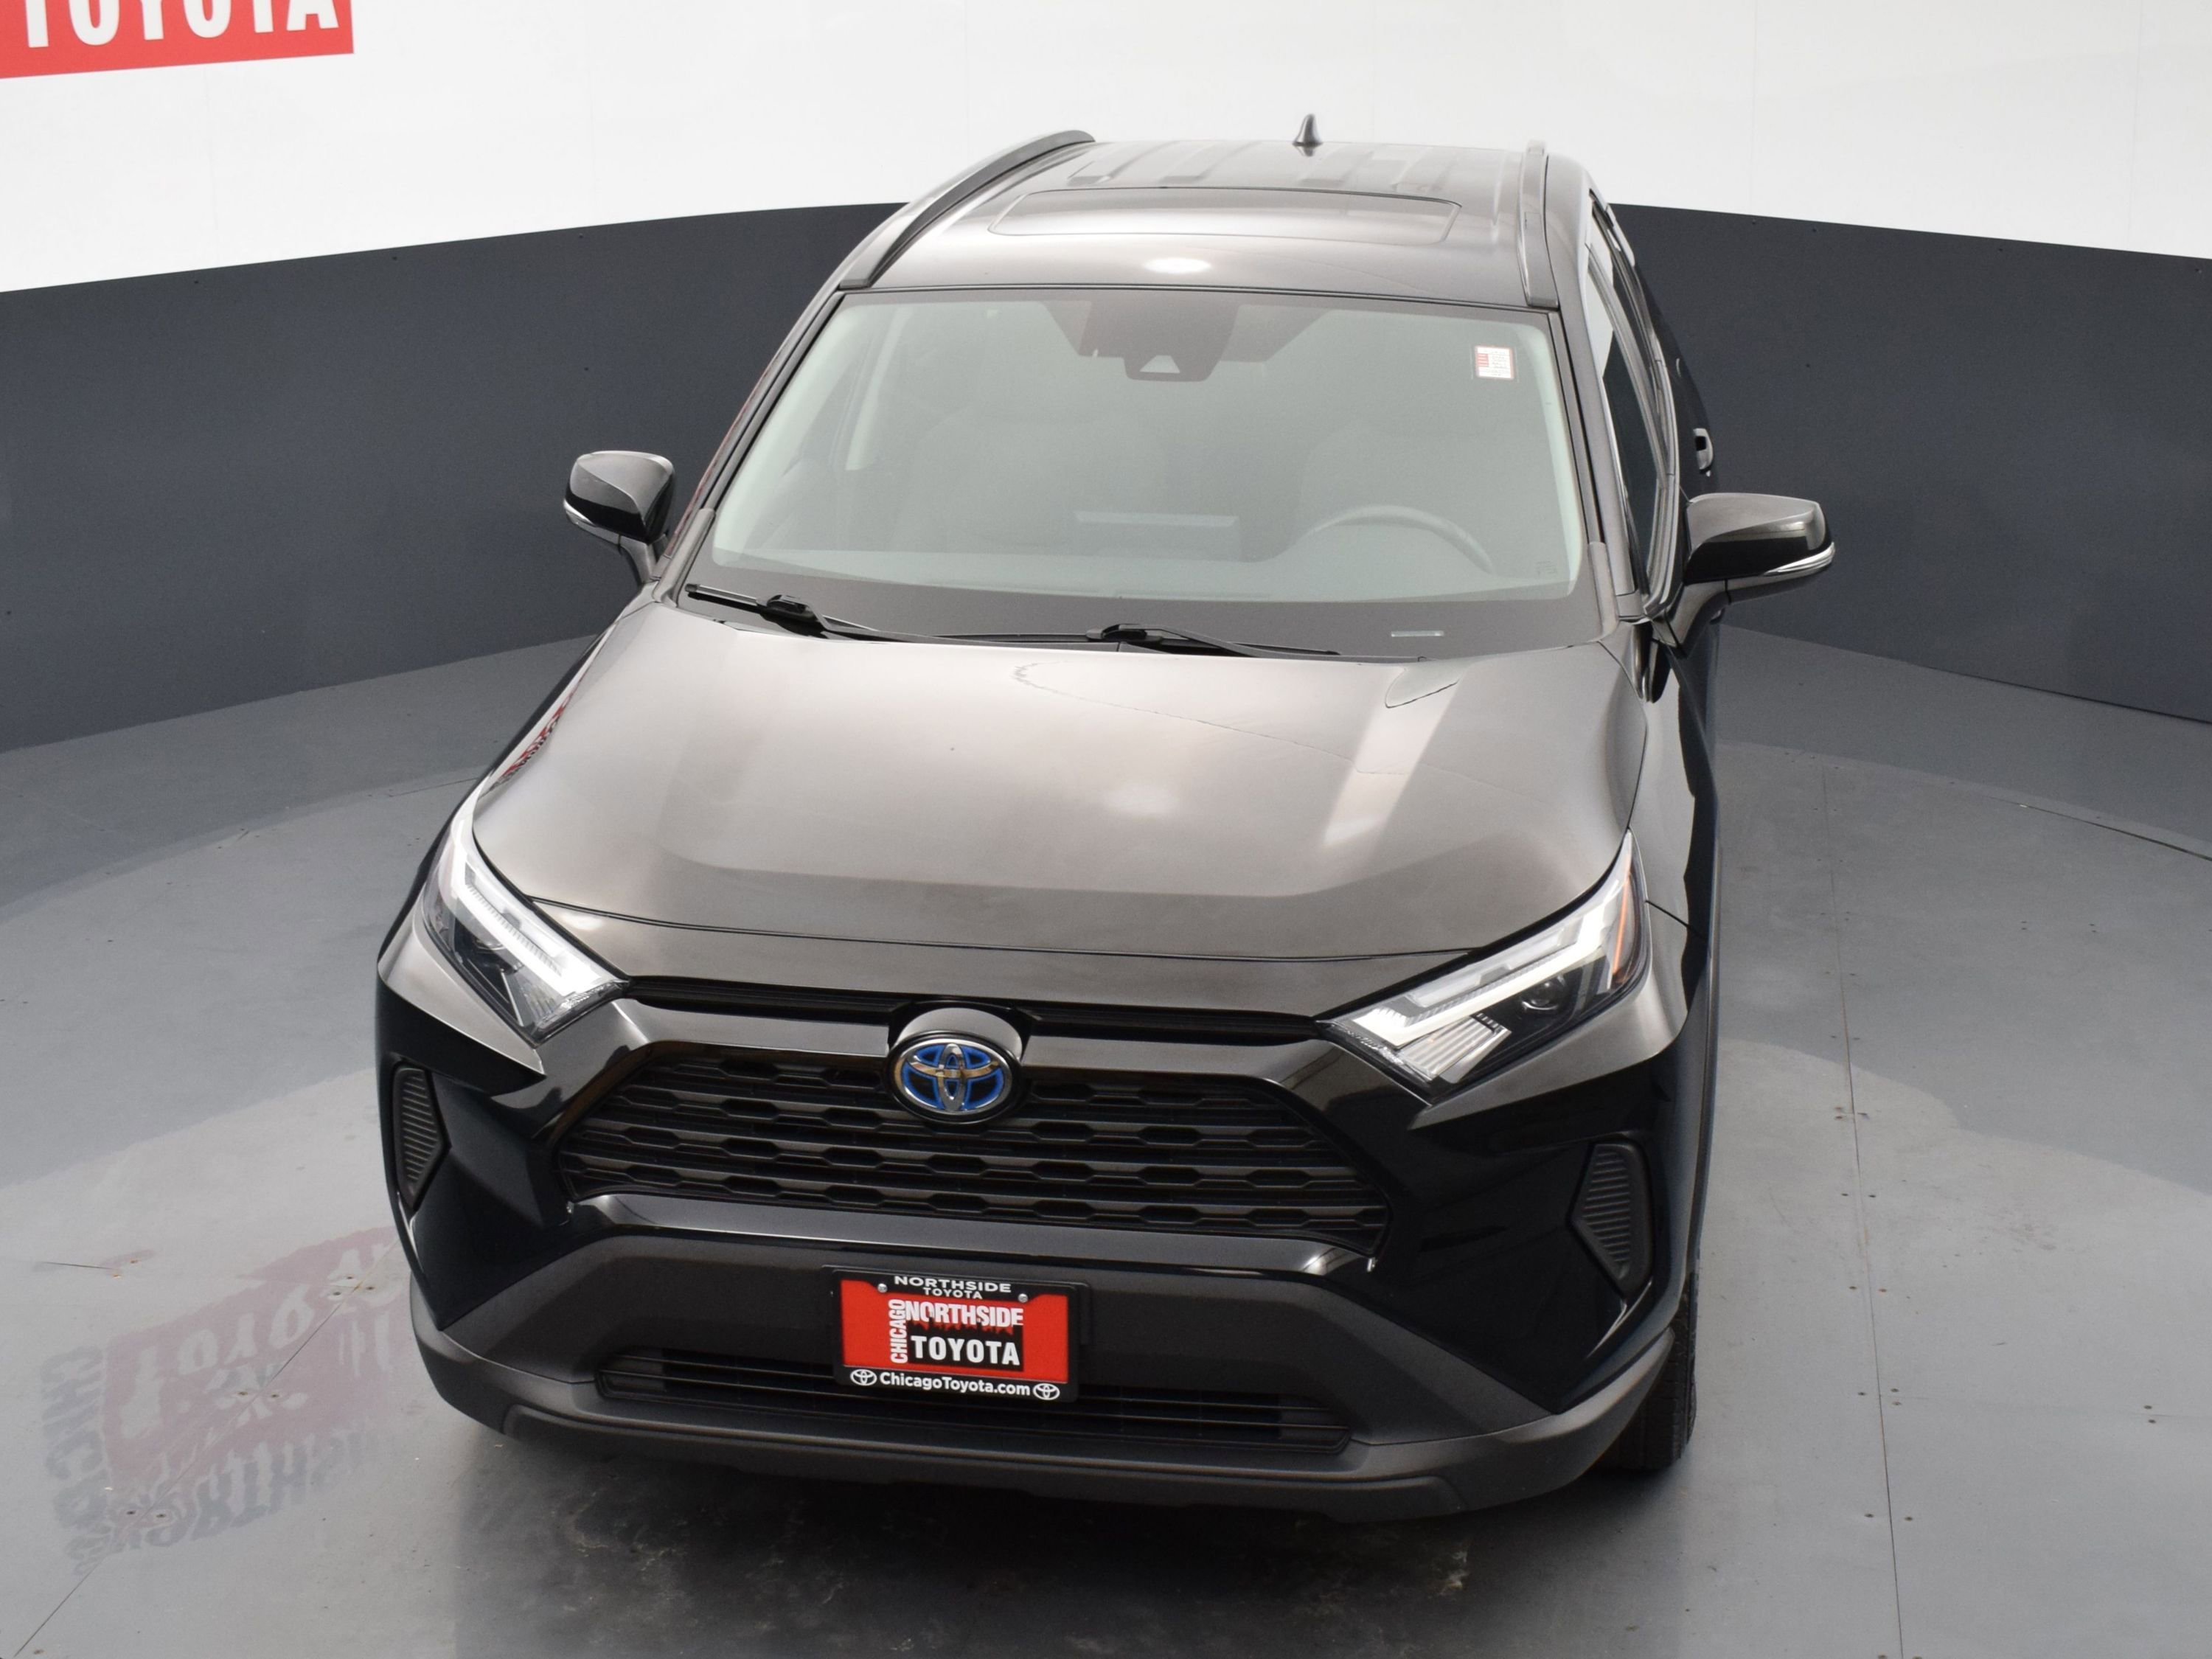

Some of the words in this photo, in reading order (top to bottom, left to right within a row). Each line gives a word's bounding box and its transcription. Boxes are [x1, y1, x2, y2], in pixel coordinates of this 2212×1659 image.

[894, 1276, 1012, 1293] NORTHSIDE
[923, 1287, 983, 1299] TOYOTA
[905, 1300, 1023, 1328] NORTHSIDE
[888, 1298, 908, 1363] CHICAGO
[910, 1335, 1020, 1366] TOYOTA
[879, 1371, 1031, 1397] ChicagoToyota.com
